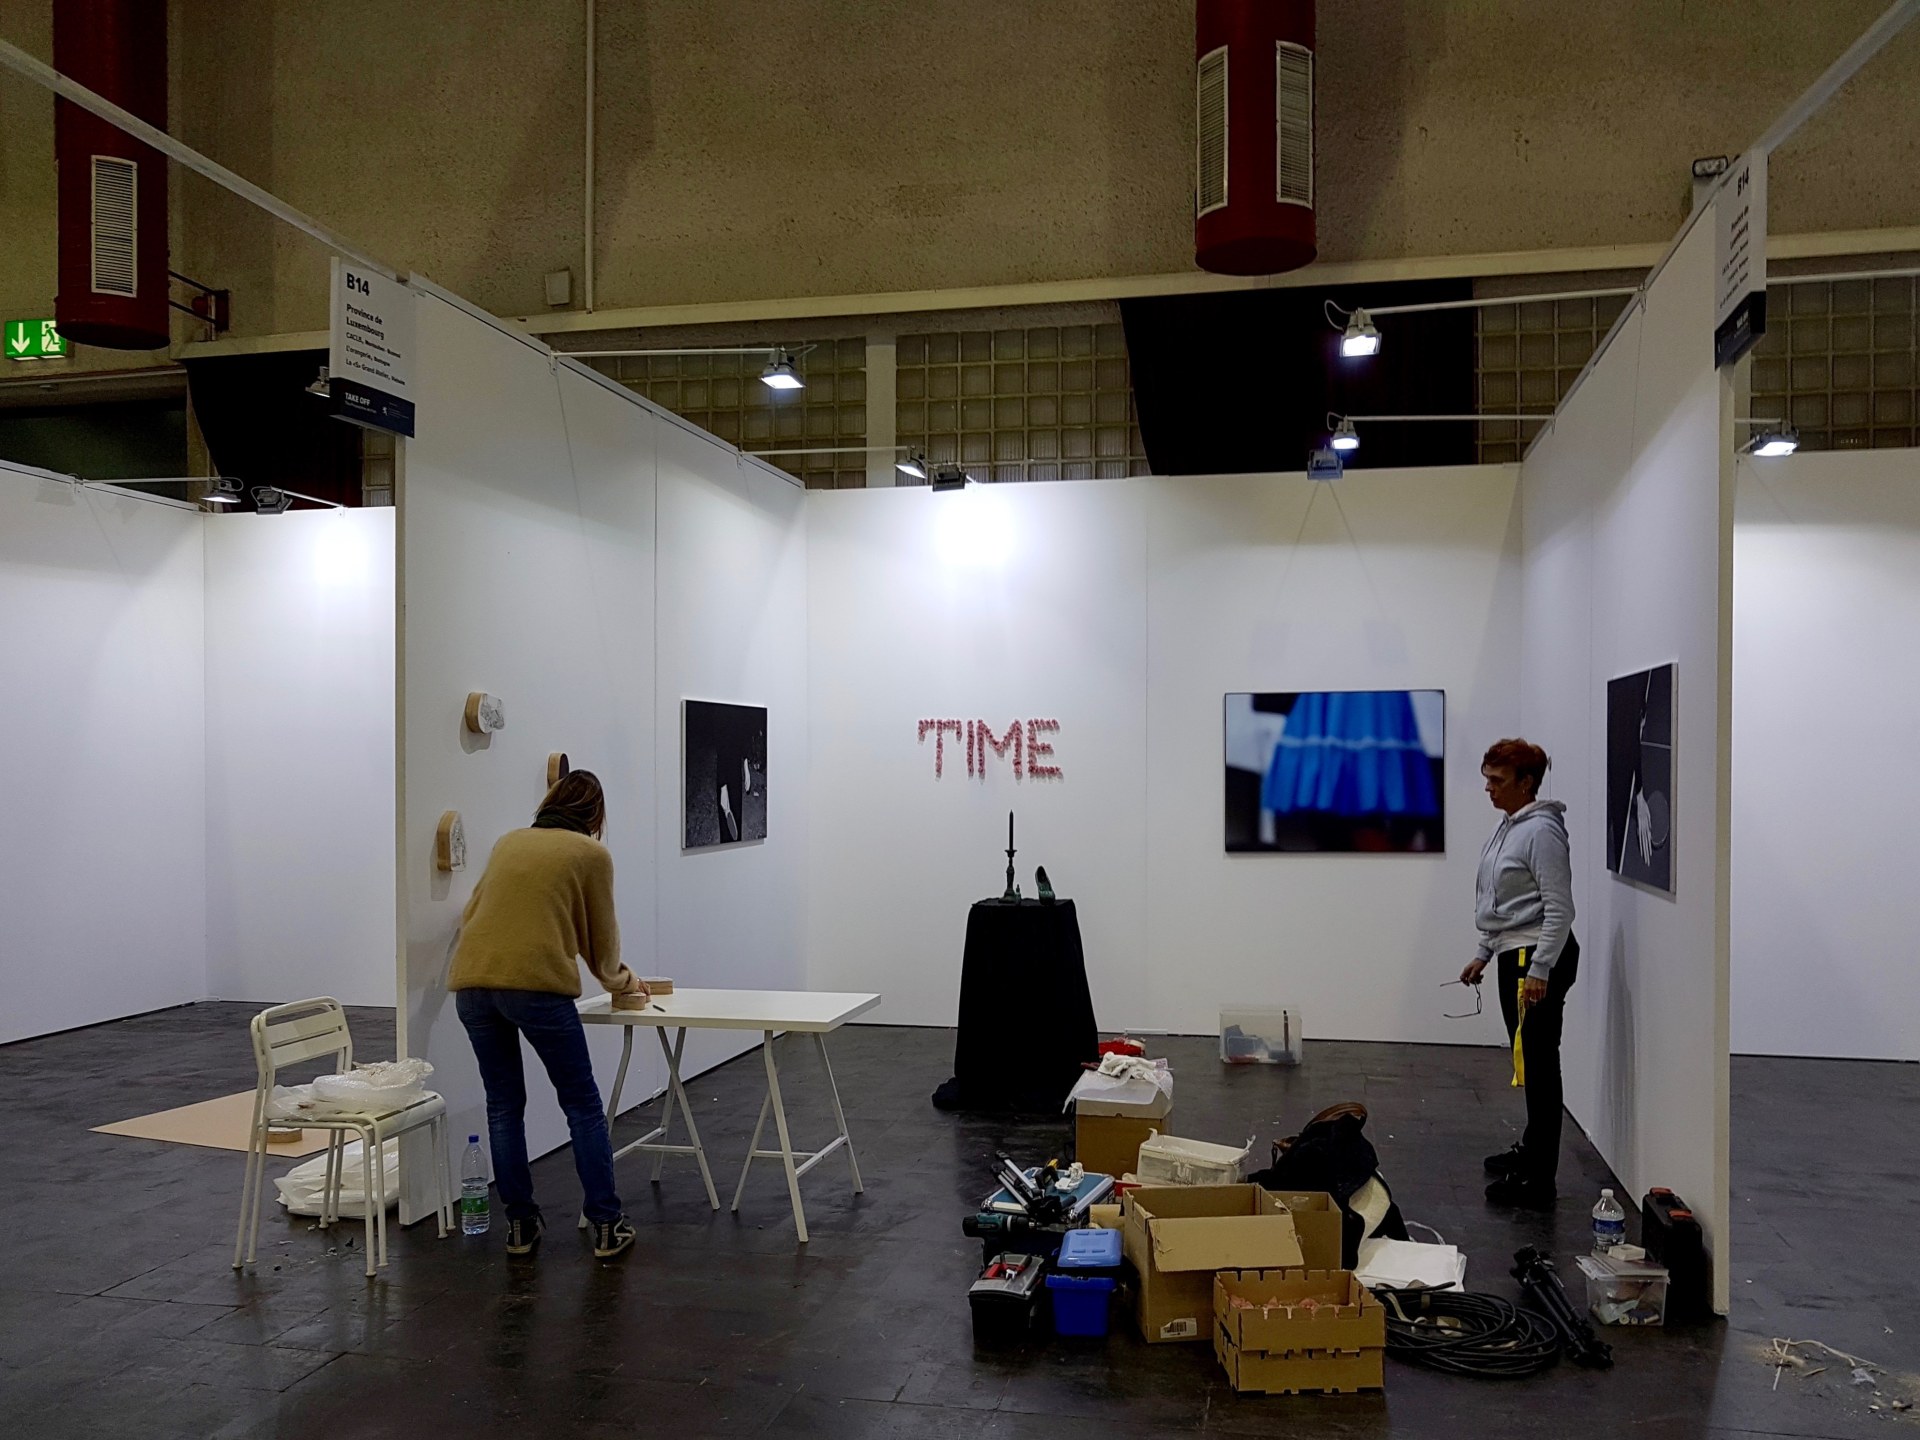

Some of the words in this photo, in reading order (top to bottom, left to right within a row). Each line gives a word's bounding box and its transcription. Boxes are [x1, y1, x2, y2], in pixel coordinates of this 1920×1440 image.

[1738, 166, 1749, 197] B14
[346, 272, 370, 296] B14
[346, 303, 374, 322] Province
[374, 315, 383, 325] de
[346, 316, 385, 341] Luxembourg
[345, 392, 359, 404] TAKE
[359, 396, 371, 406] OFF
[918, 717, 1064, 784] TIME
